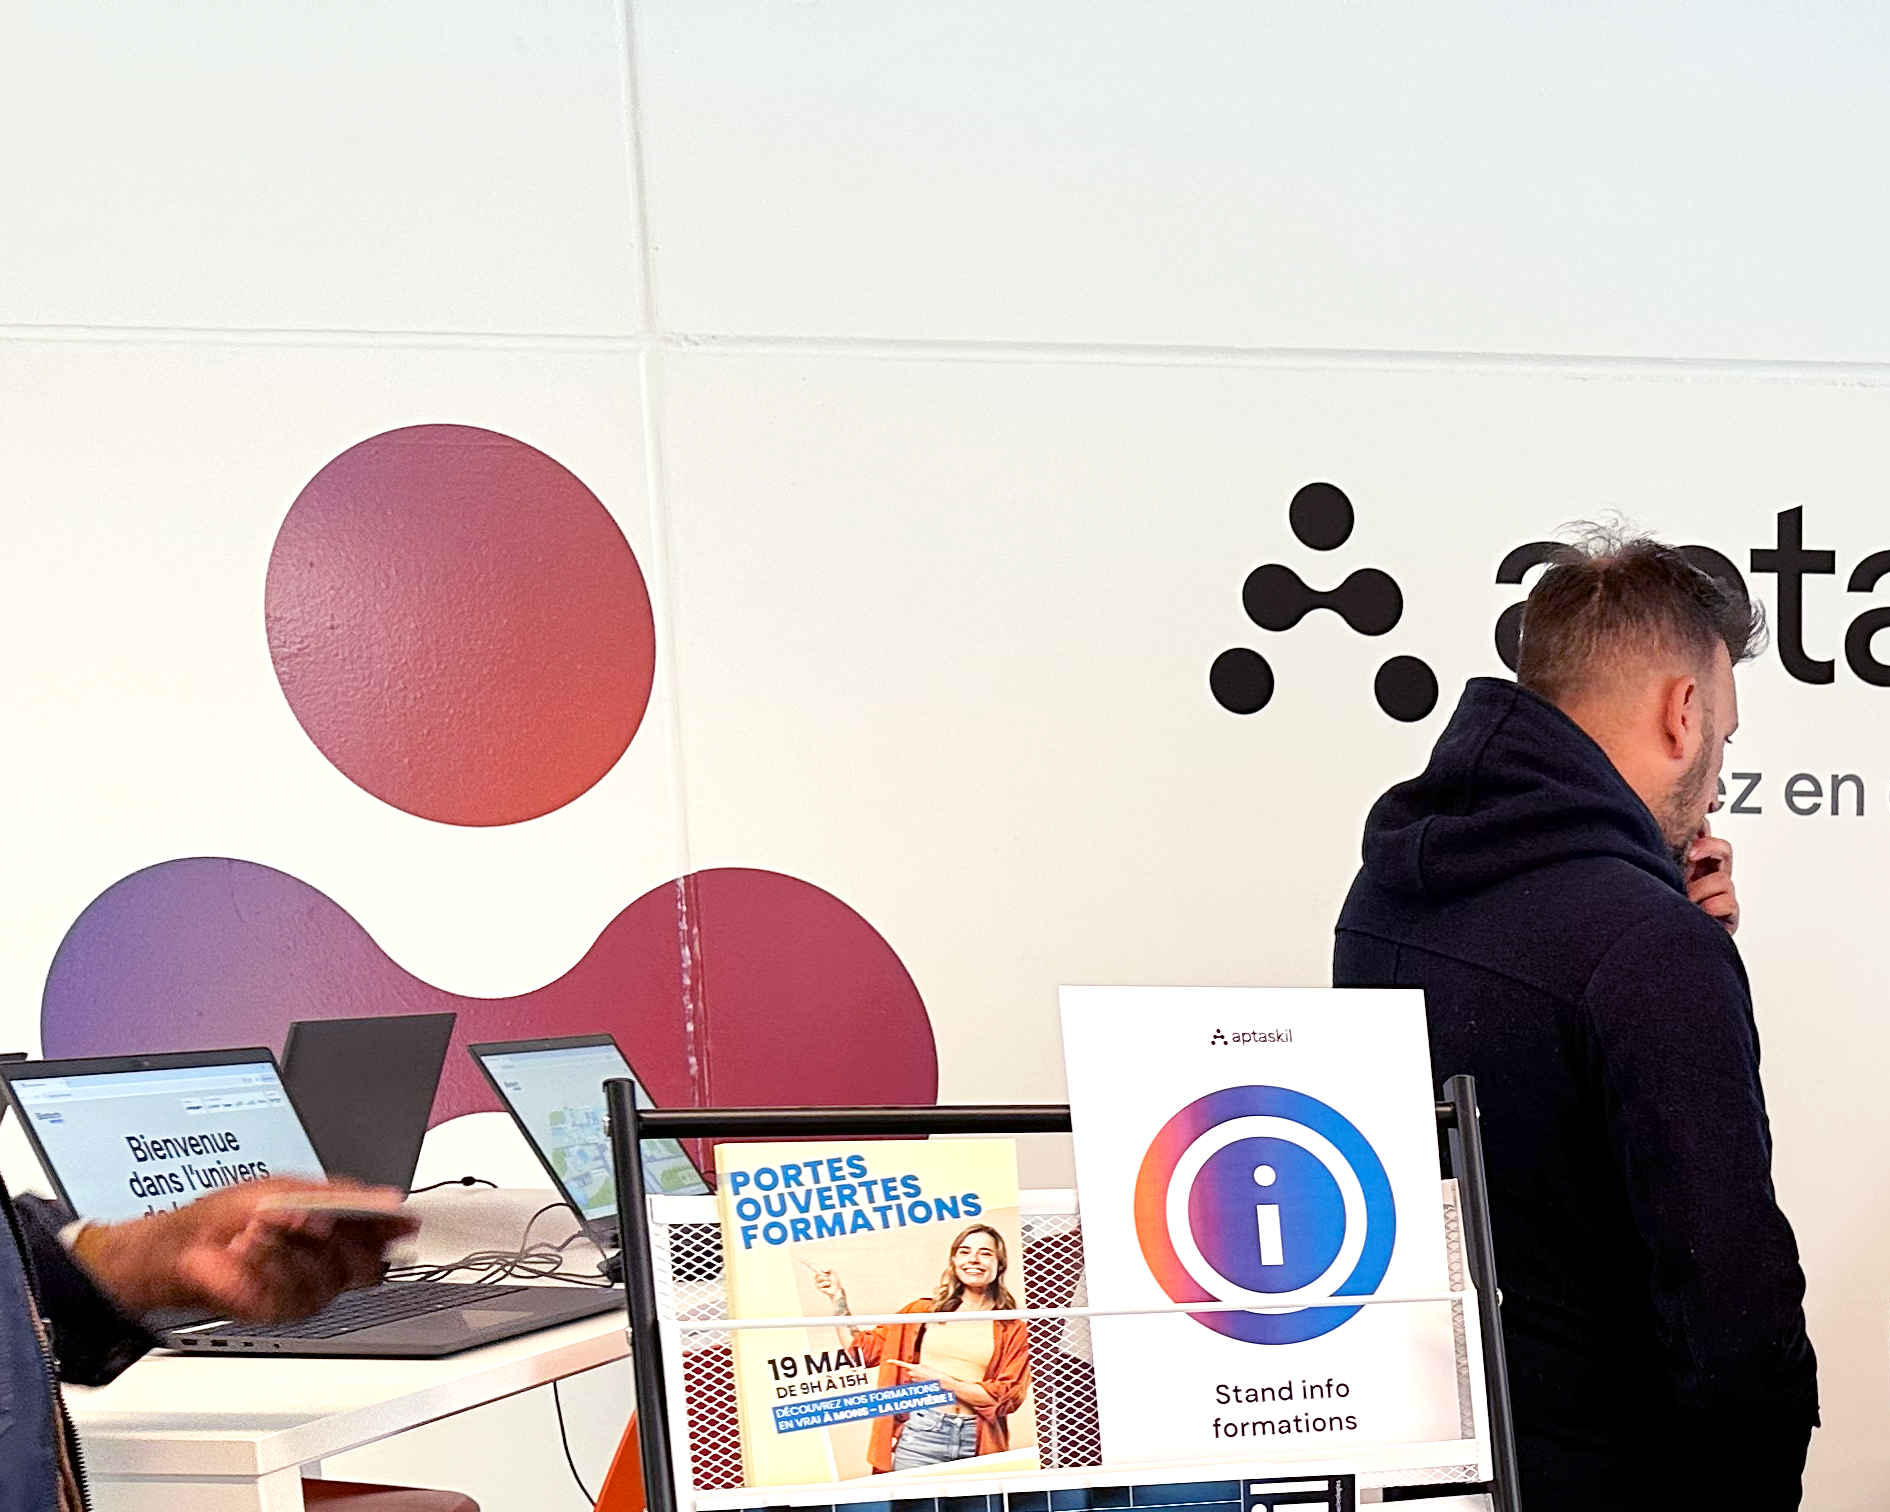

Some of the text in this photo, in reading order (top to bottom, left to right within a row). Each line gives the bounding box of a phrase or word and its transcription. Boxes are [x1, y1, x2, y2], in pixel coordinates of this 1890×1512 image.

[1784, 768, 1865, 819] en
[1231, 1029, 1293, 1046] aptaskil
[125, 1130, 240, 1162] Bienvenue
[129, 1160, 270, 1198] dans l'univers
[730, 1154, 867, 1195] PORTES
[735, 1174, 921, 1221] OUVERTES
[740, 1193, 983, 1250] FORMATIONS
[768, 1346, 863, 1381] 19 MAI
[776, 1373, 868, 1399] DE 9H À 15H
[776, 1383, 940, 1418] DÉCOUVREZ NOS FORMATIONS
[1215, 1377, 1350, 1405] Stand info
[778, 1394, 946, 1430] EN VRAI À MONS LA LOUVIÈRE
[1213, 1412, 1357, 1439] formations
